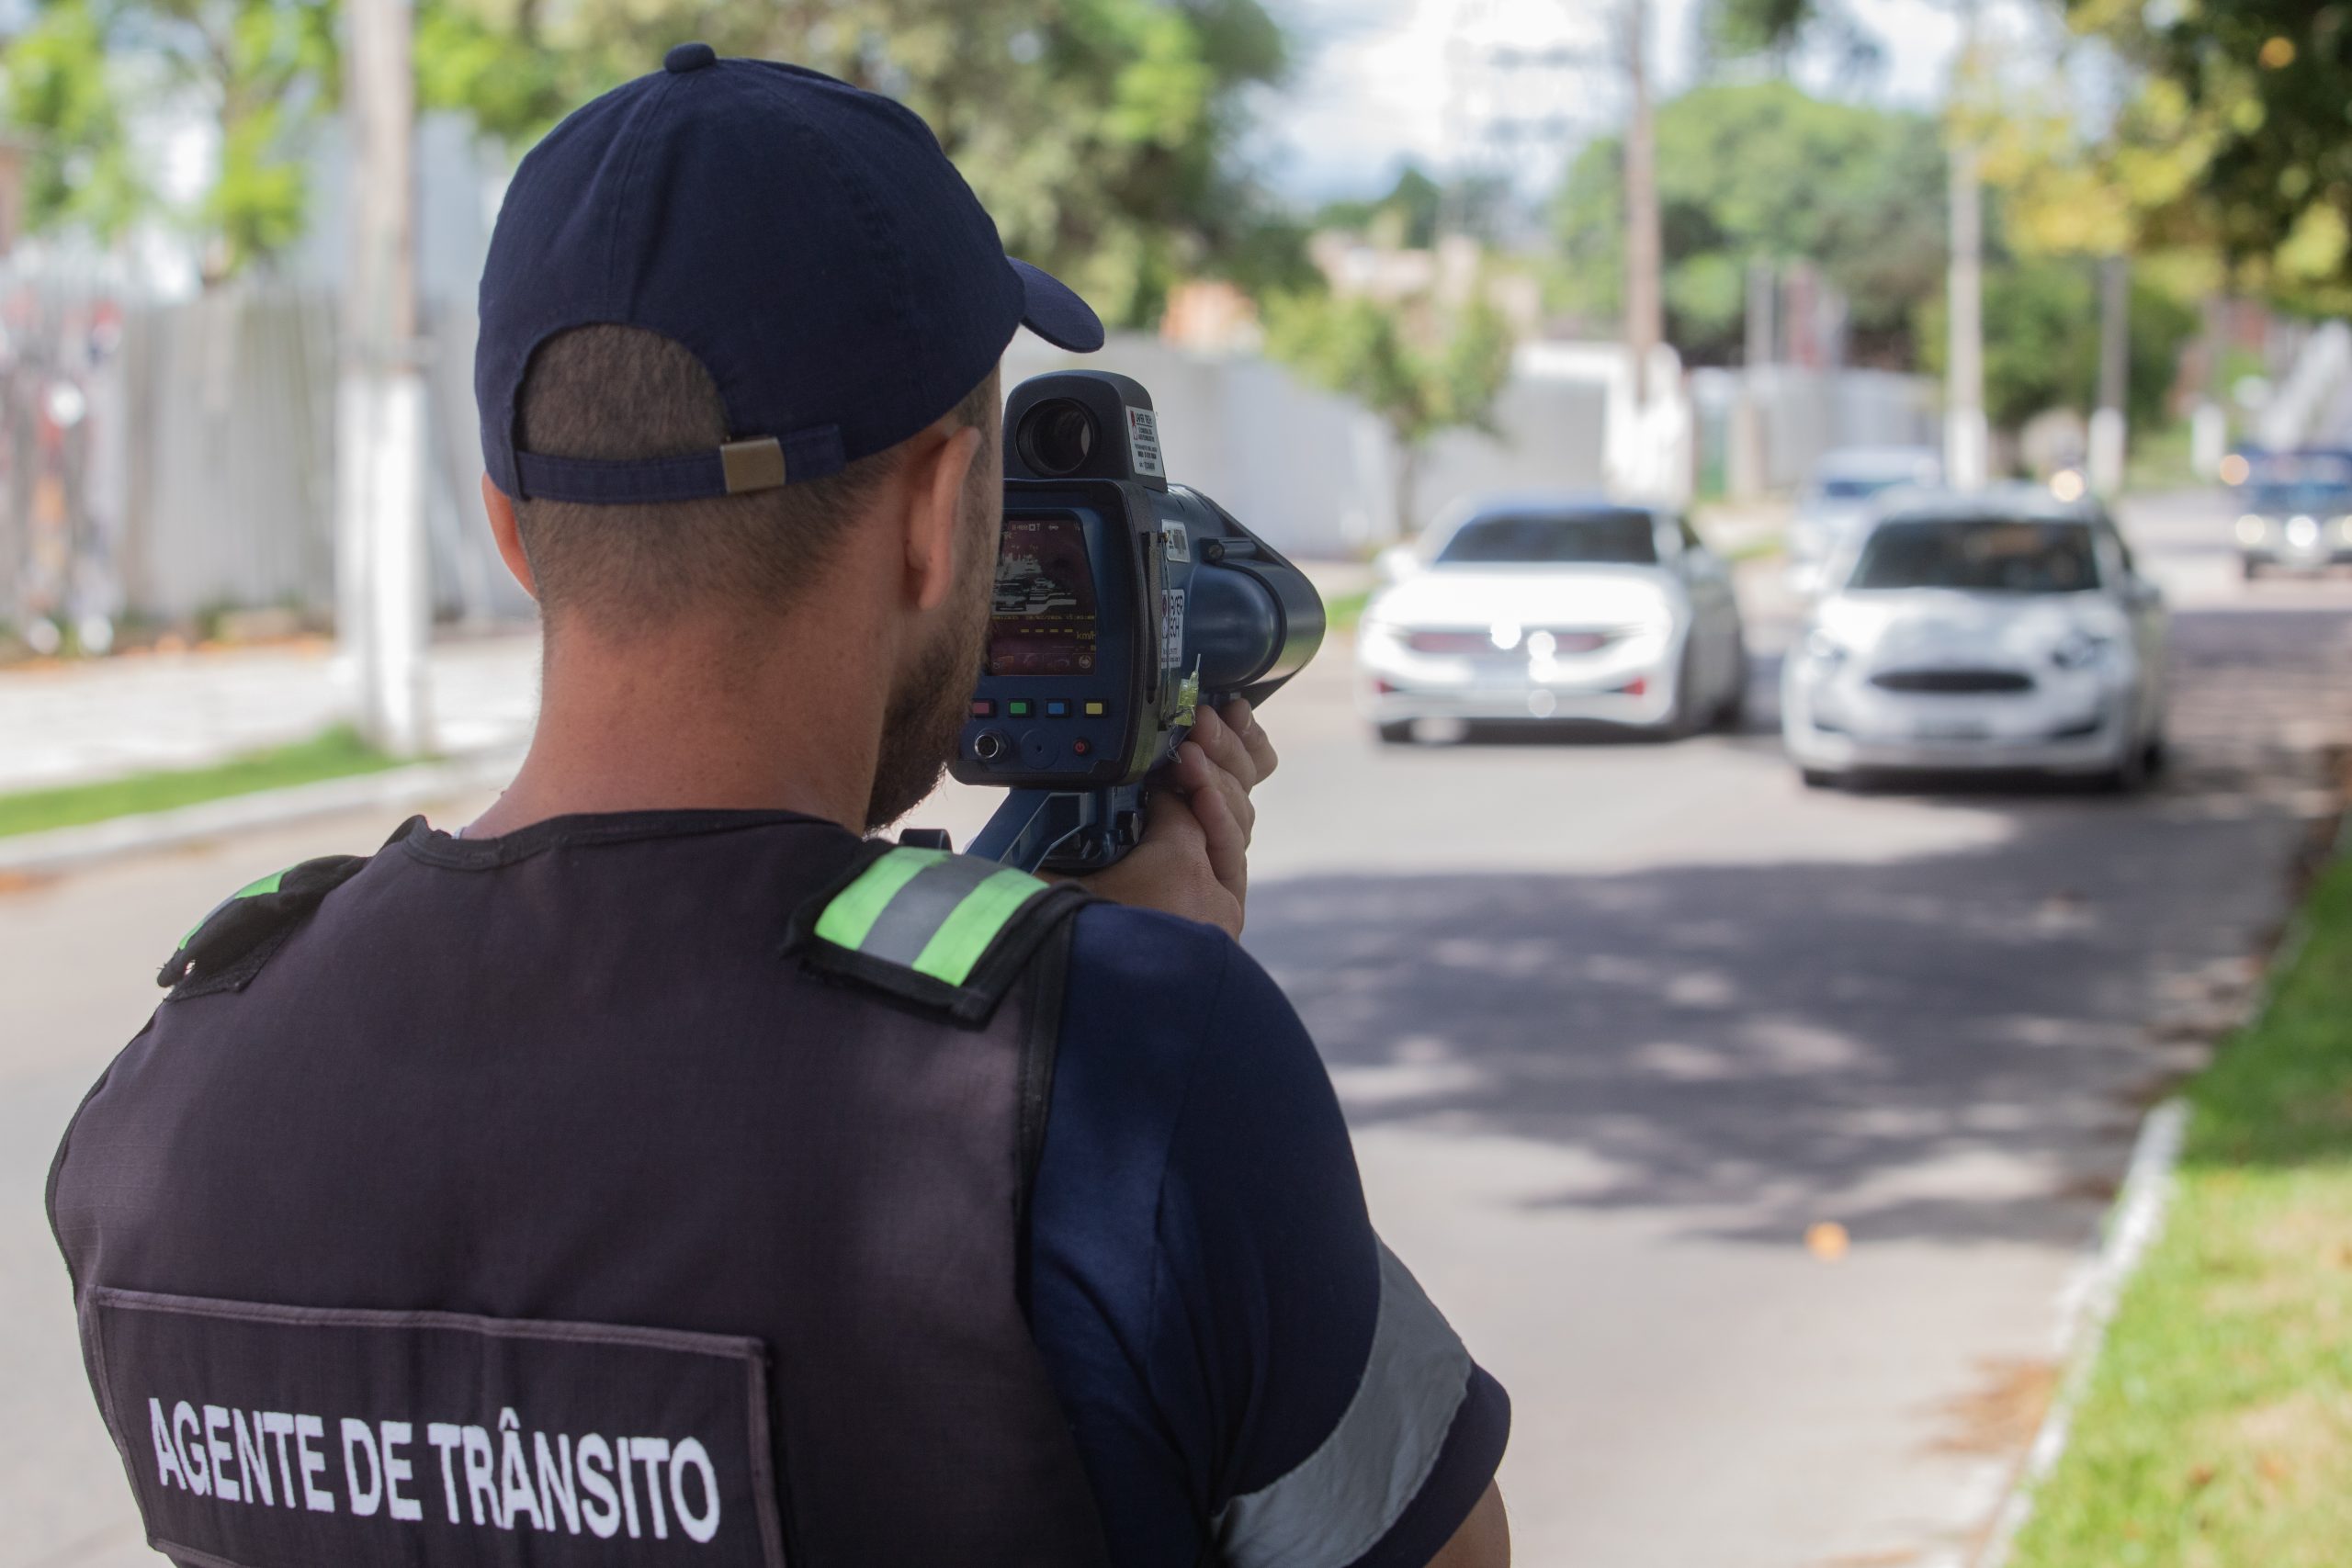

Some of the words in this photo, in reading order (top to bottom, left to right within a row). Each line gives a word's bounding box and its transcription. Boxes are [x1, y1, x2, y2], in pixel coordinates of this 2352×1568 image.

[150, 1398, 334, 1512] AGENTE
[341, 1418, 422, 1520] DE
[428, 1407, 719, 1541] TRÂNSITO
